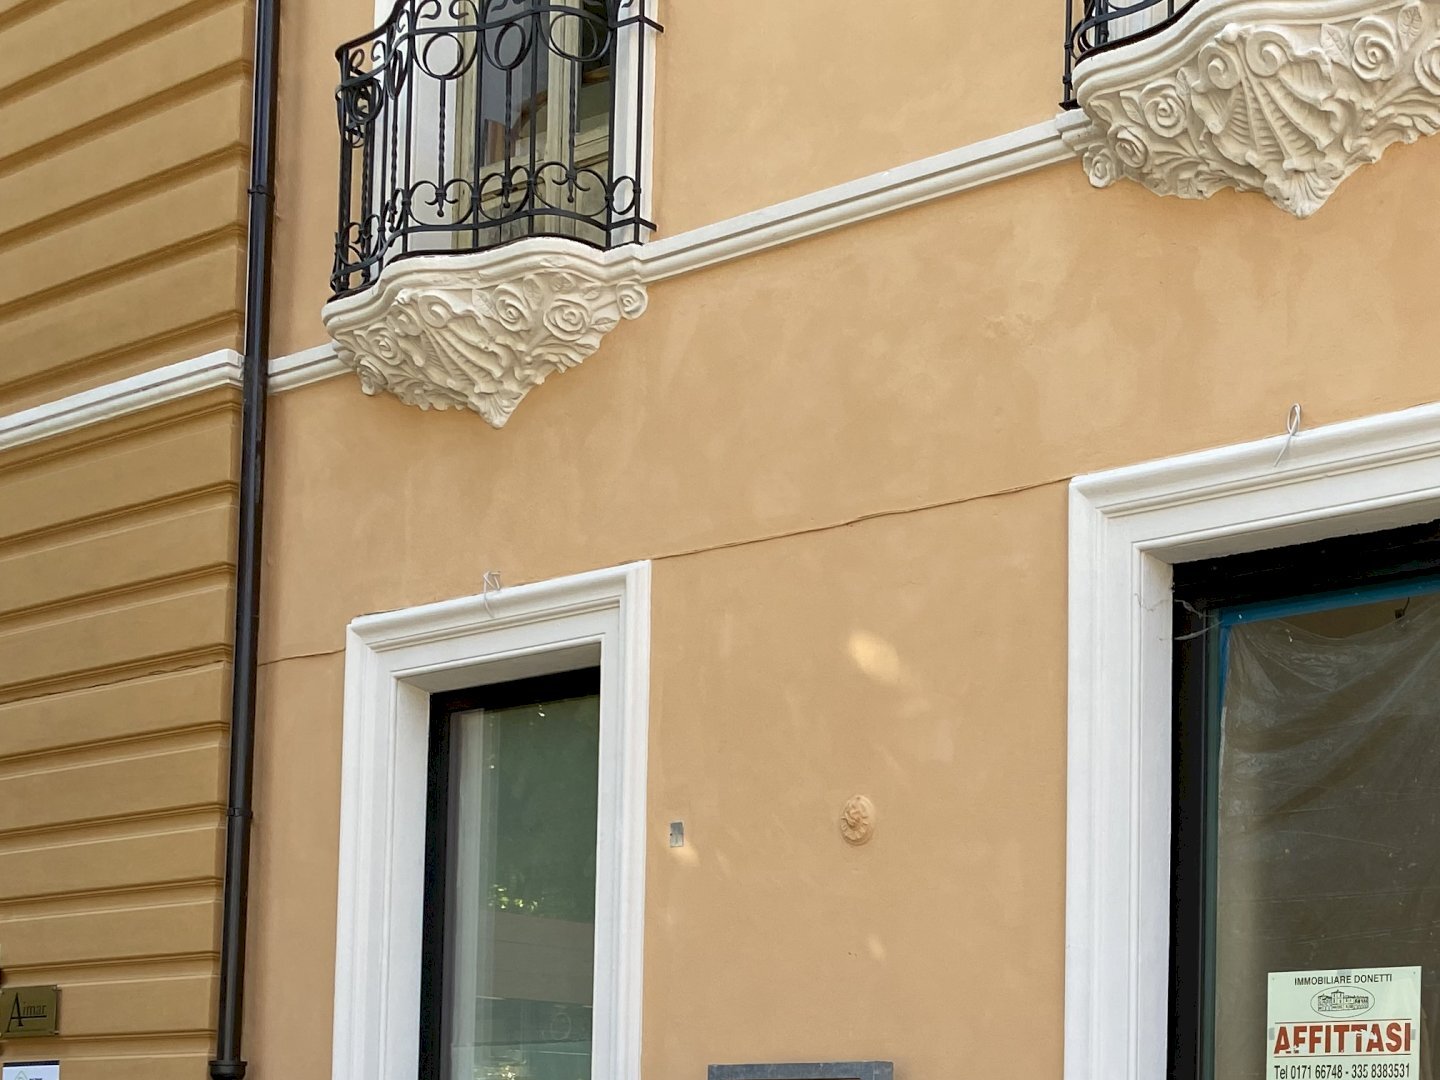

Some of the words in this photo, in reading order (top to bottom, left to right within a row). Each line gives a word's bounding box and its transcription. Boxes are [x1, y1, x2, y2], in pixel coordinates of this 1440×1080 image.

[1295, 975, 1352, 986] IMMOBILIARE
[1354, 974, 1393, 984] DONETTI
[1273, 1022, 1411, 1054] AFFITTASI
[1274, 1065, 1288, 1080] Tel
[1291, 1065, 1312, 1079] 0171
[1315, 1064, 1343, 1079] 66748
[1351, 1064, 1368, 1079] 335
[1371, 1063, 1410, 1078] 8383531
